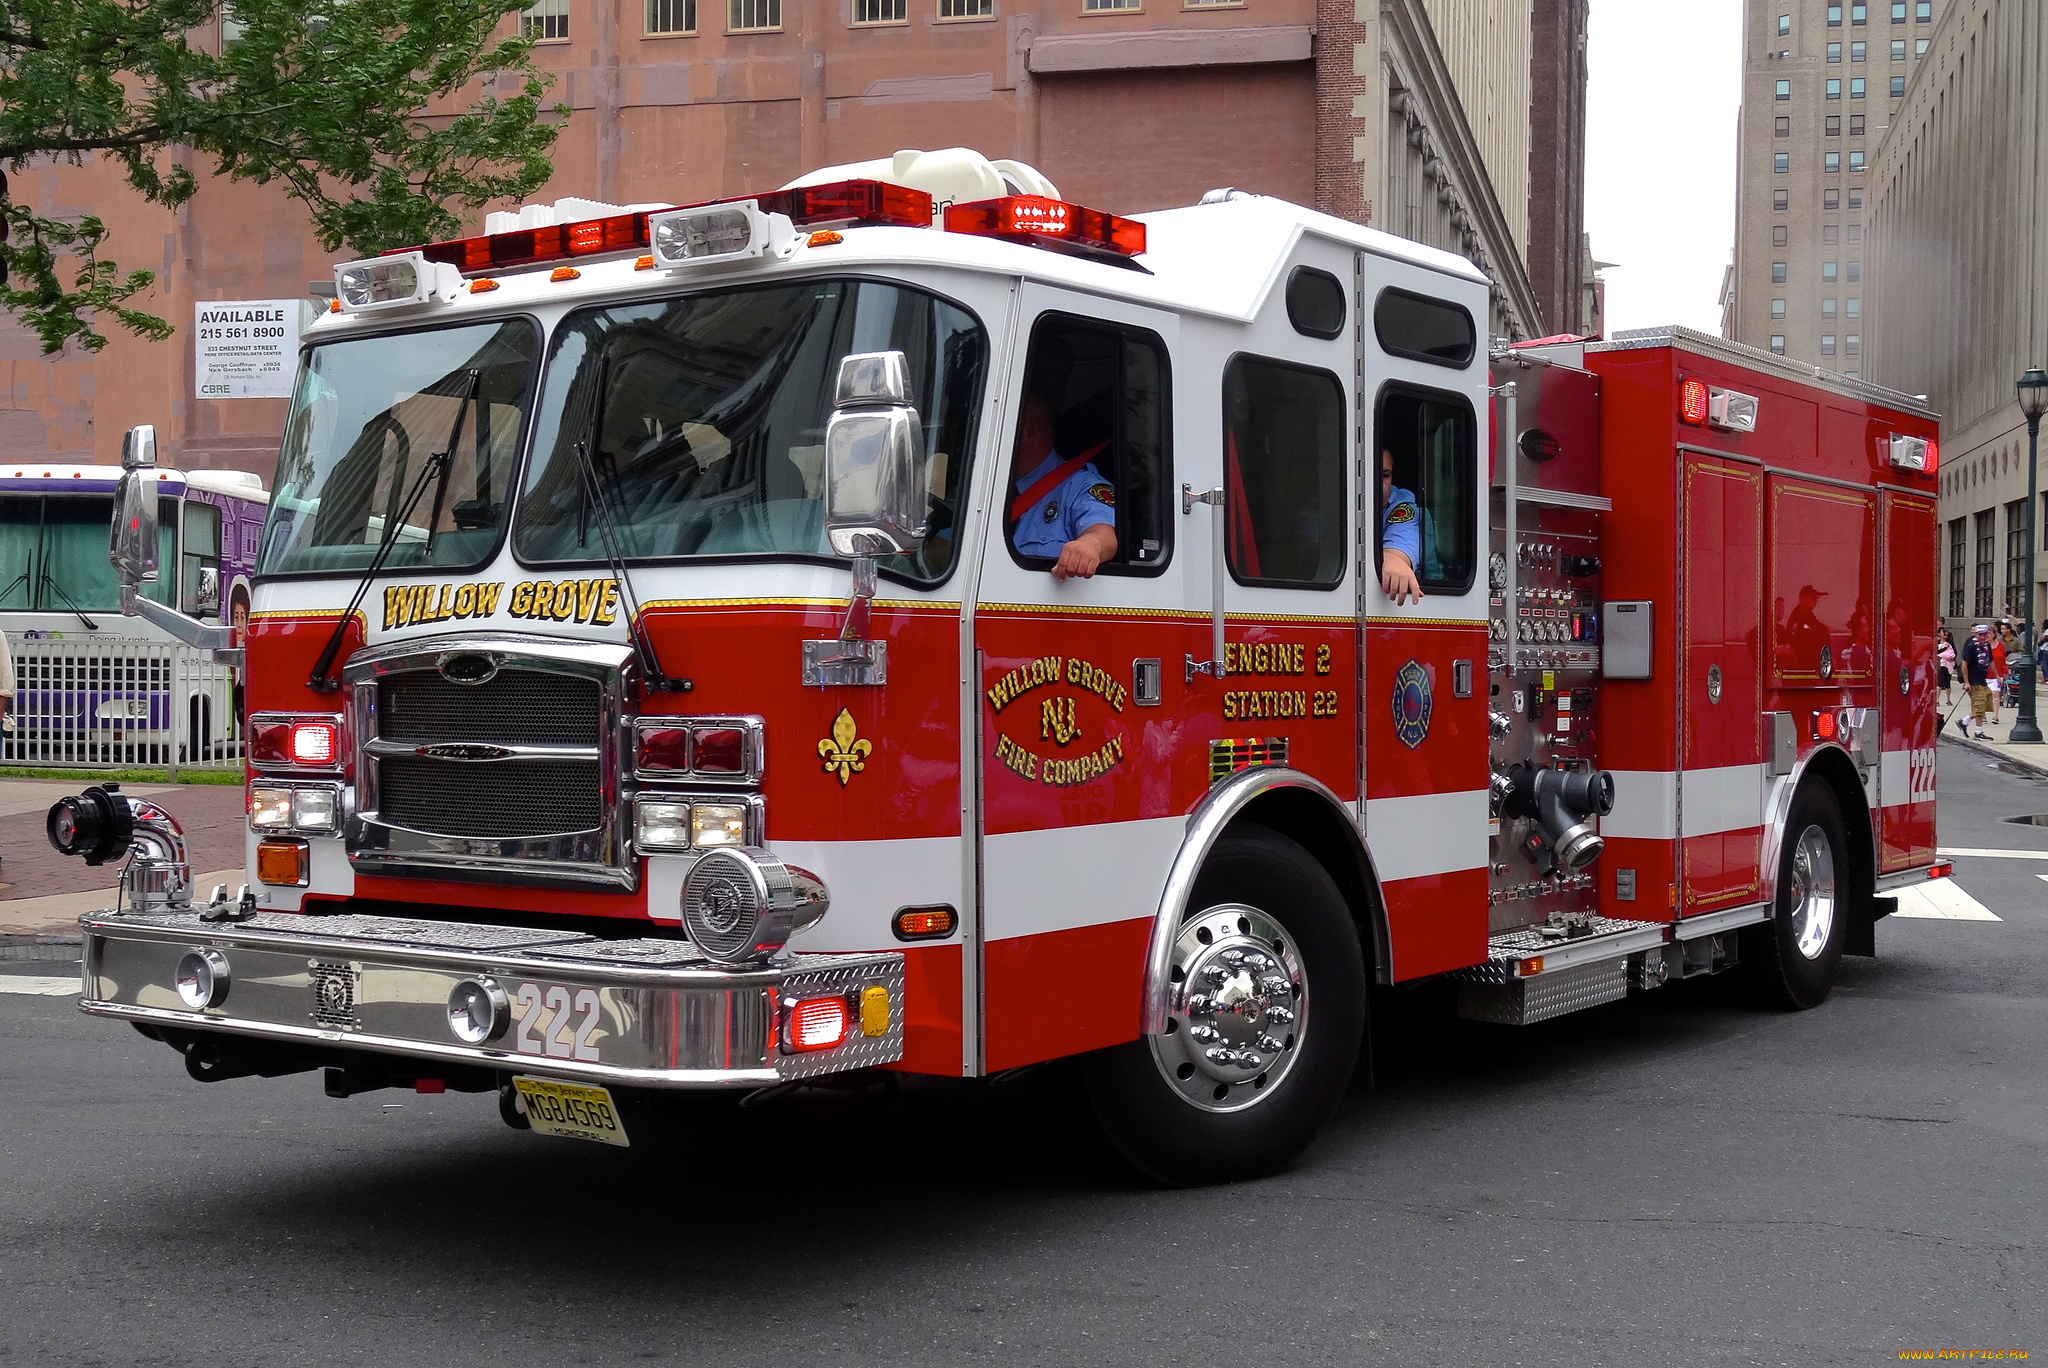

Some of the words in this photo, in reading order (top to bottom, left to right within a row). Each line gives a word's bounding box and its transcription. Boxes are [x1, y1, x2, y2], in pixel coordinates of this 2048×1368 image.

[200, 310, 284, 323] AVAILABLE
[200, 328, 222, 339] 215
[226, 327, 248, 338] 561
[253, 327, 284, 338] 8900
[201, 384, 230, 394] CBRE
[382, 582, 505, 632] WILLOW
[508, 578, 622, 627] GROVE
[1223, 642, 1305, 674] ENGINE
[1315, 643, 1331, 673] 2
[986, 656, 1063, 712] WILLOW
[1066, 657, 1128, 713] GROVE
[1223, 690, 1306, 719] STATION
[1313, 690, 1338, 716] 22
[993, 733, 1038, 780] FIRE
[1042, 732, 1123, 785] COMPANY
[1911, 747, 1936, 804] 222
[517, 982, 600, 1064] 222
[536, 1081, 558, 1093] New
[558, 1085, 586, 1100] Jersey
[554, 1127, 605, 1141] MUNICIPAL
